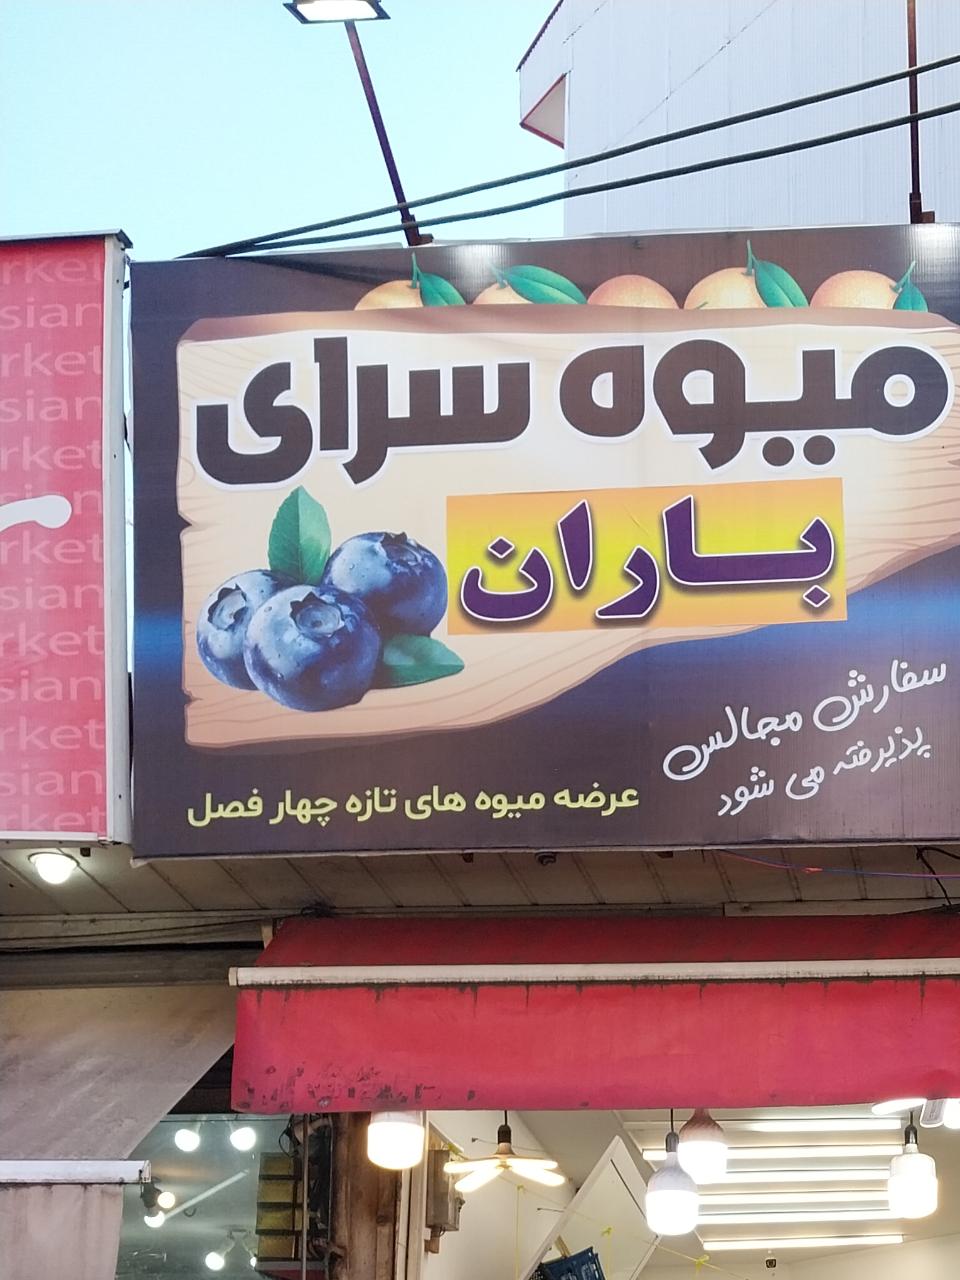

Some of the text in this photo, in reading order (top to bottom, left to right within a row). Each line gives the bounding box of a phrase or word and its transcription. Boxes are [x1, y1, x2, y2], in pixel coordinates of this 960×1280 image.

[196, 337, 950, 486] میوه سرای
[460, 495, 836, 624] باران
[662, 658, 947, 781] سفارش مجالس
[717, 725, 932, 817] پذیرفته می شود
[188, 782, 640, 828] عرضه میوه های تازه چهار فصل
